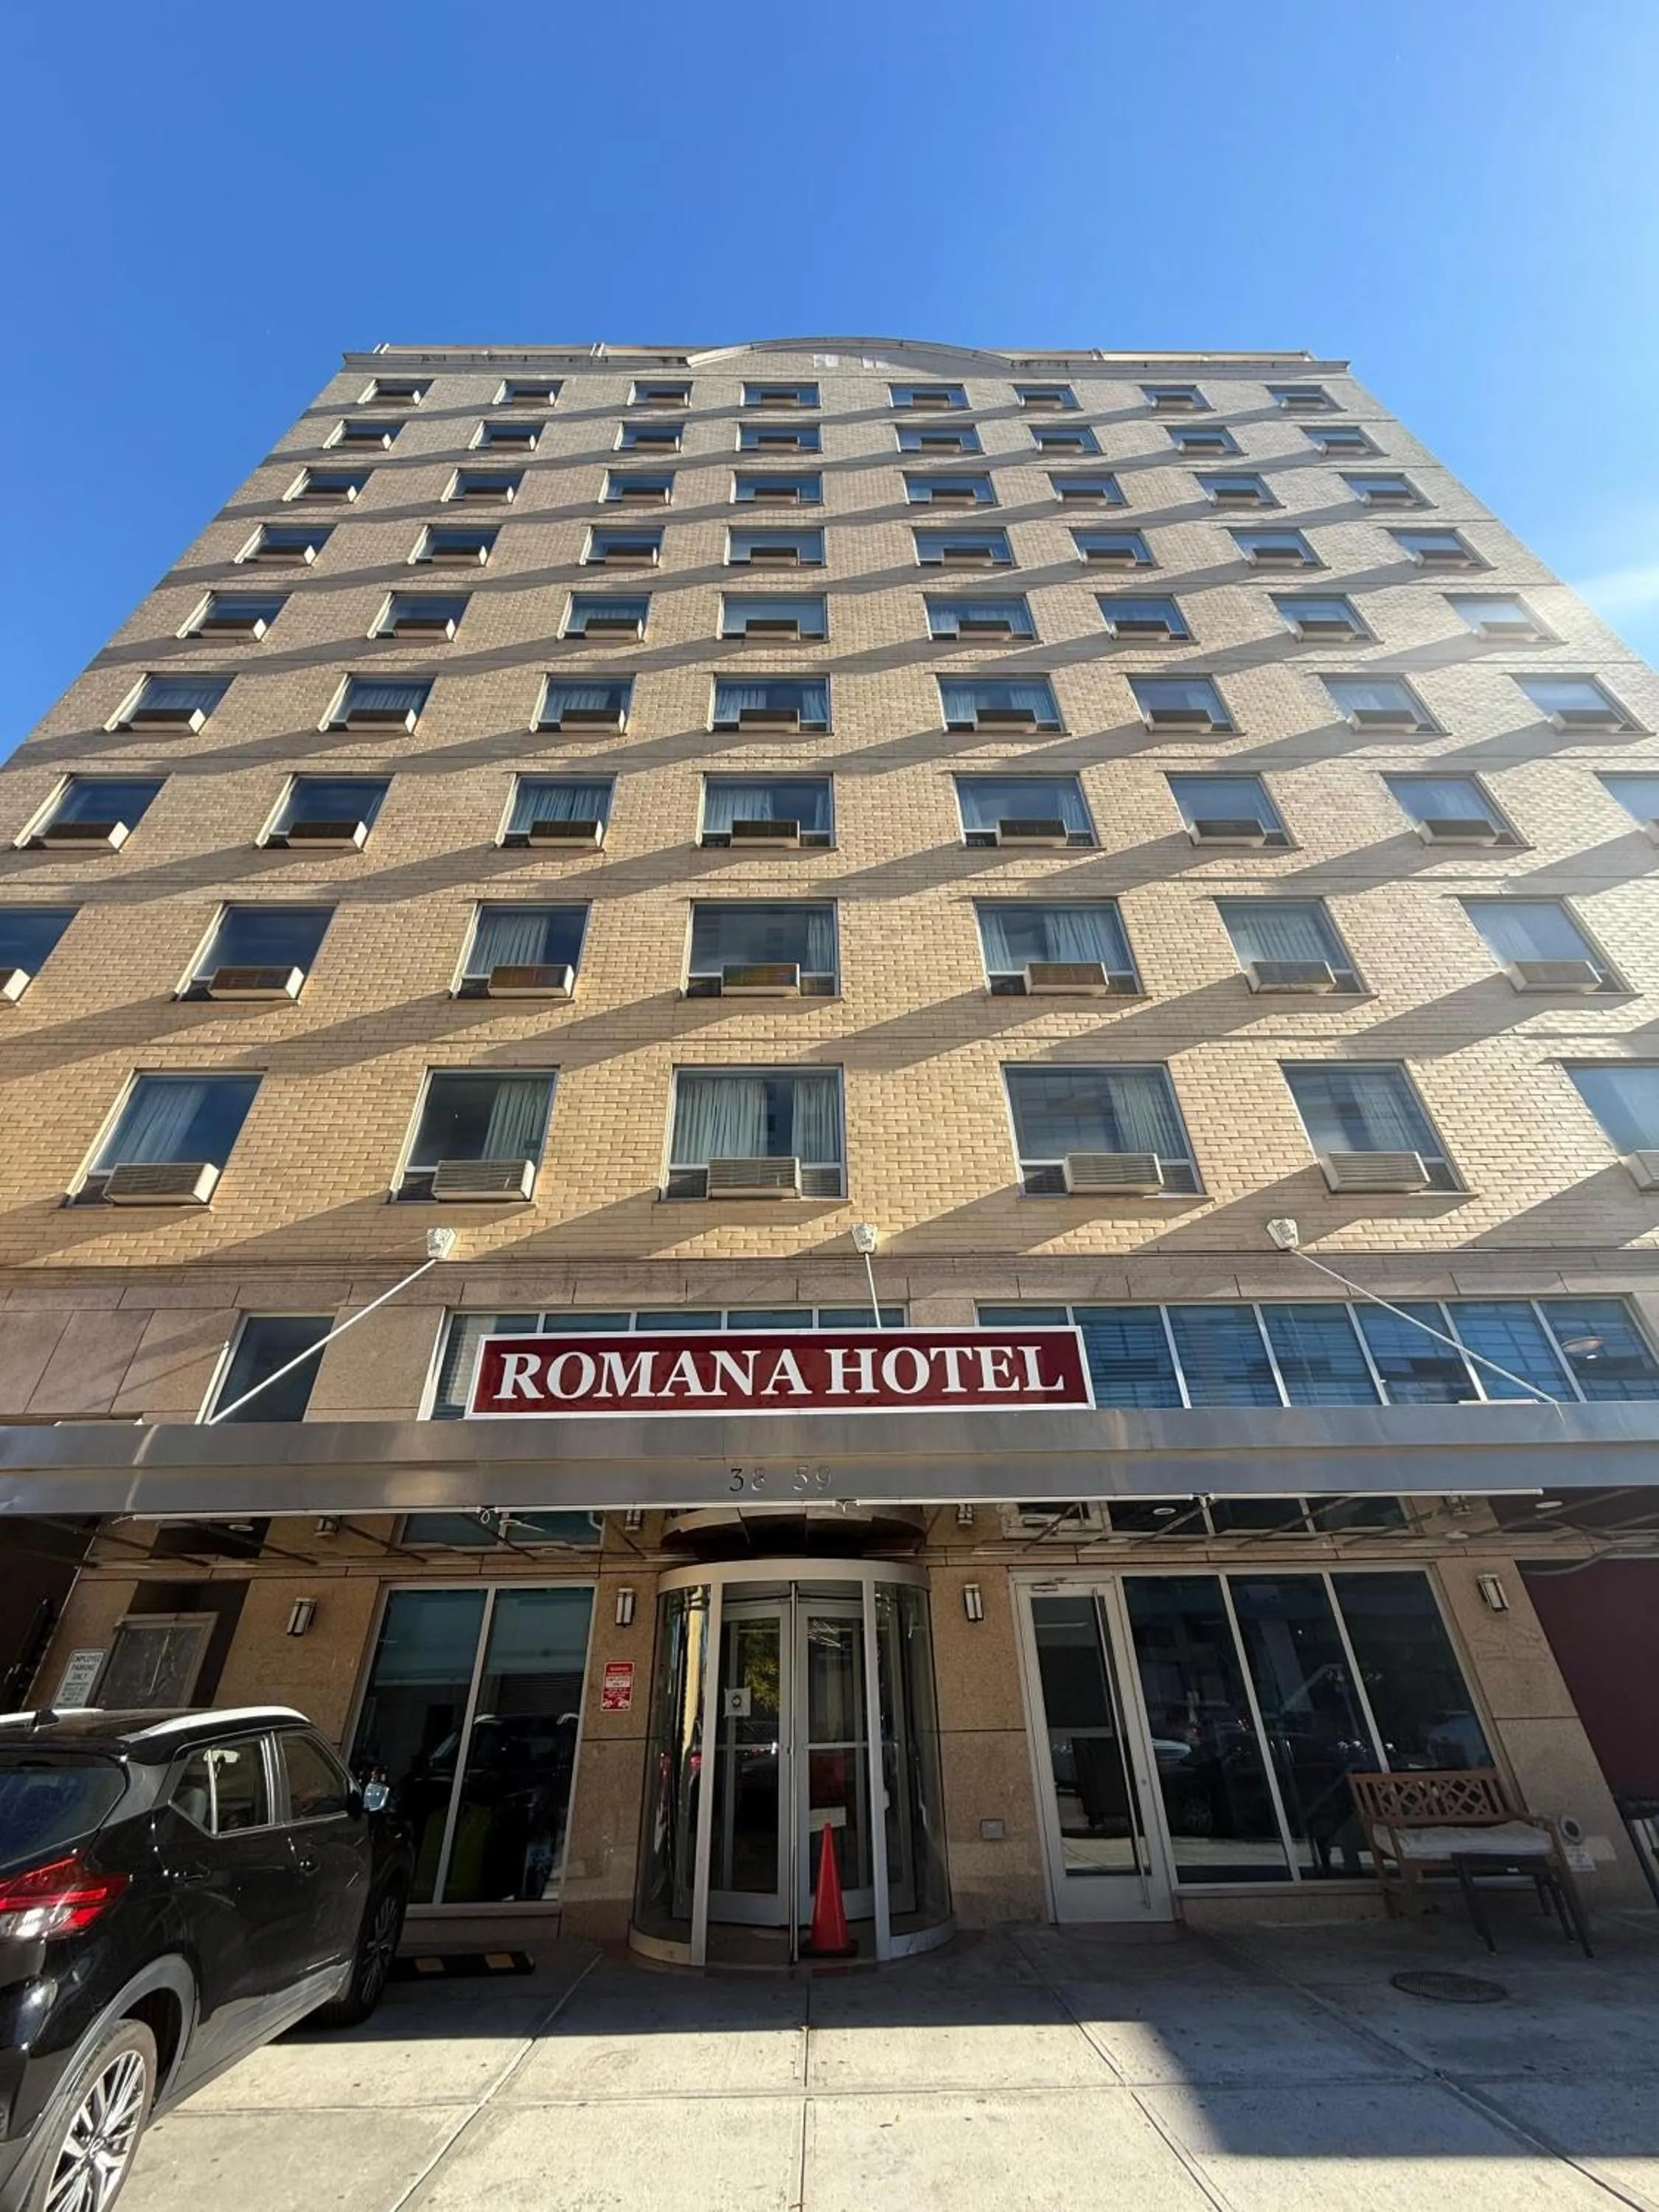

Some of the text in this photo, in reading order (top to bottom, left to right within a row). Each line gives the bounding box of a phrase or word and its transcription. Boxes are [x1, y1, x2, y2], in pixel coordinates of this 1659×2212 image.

[493, 1346, 1065, 1399] ROMANA HOTEL
[729, 1465, 831, 1492] 38 59
